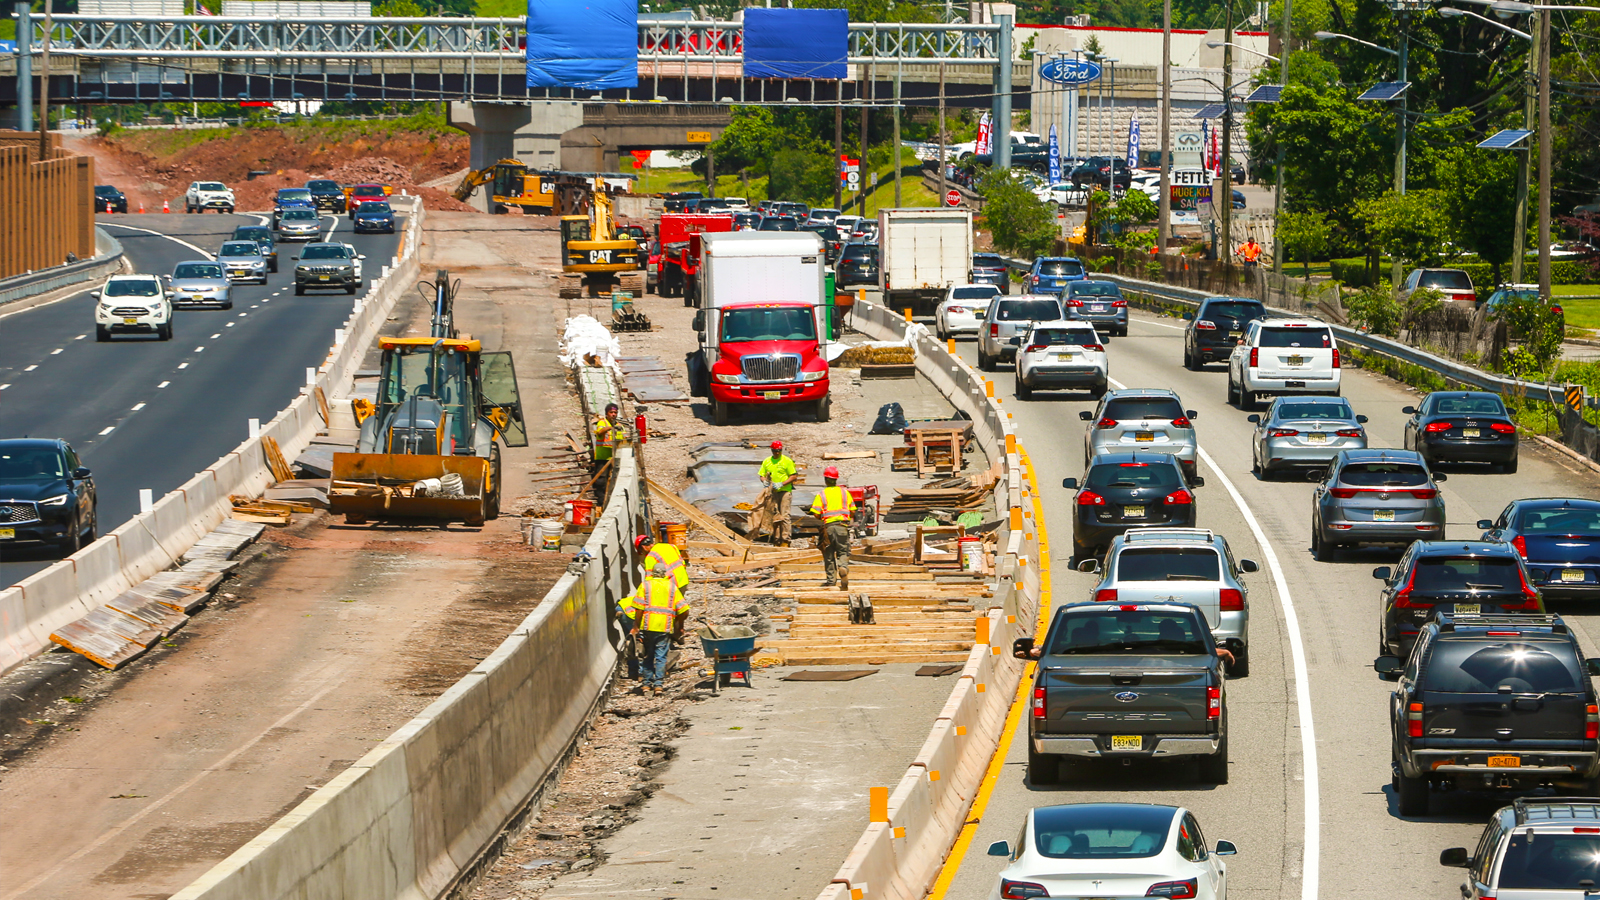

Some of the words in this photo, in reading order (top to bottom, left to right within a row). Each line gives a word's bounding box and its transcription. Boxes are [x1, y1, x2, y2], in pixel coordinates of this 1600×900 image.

[1053, 63, 1089, 80] Ford
[1129, 122, 1138, 169] FORD
[1174, 171, 1210, 184] FETTE
[946, 194, 961, 202] STOP
[1172, 187, 1195, 197] HUGE
[1196, 187, 1211, 197] KIA
[589, 249, 613, 264] CAT
